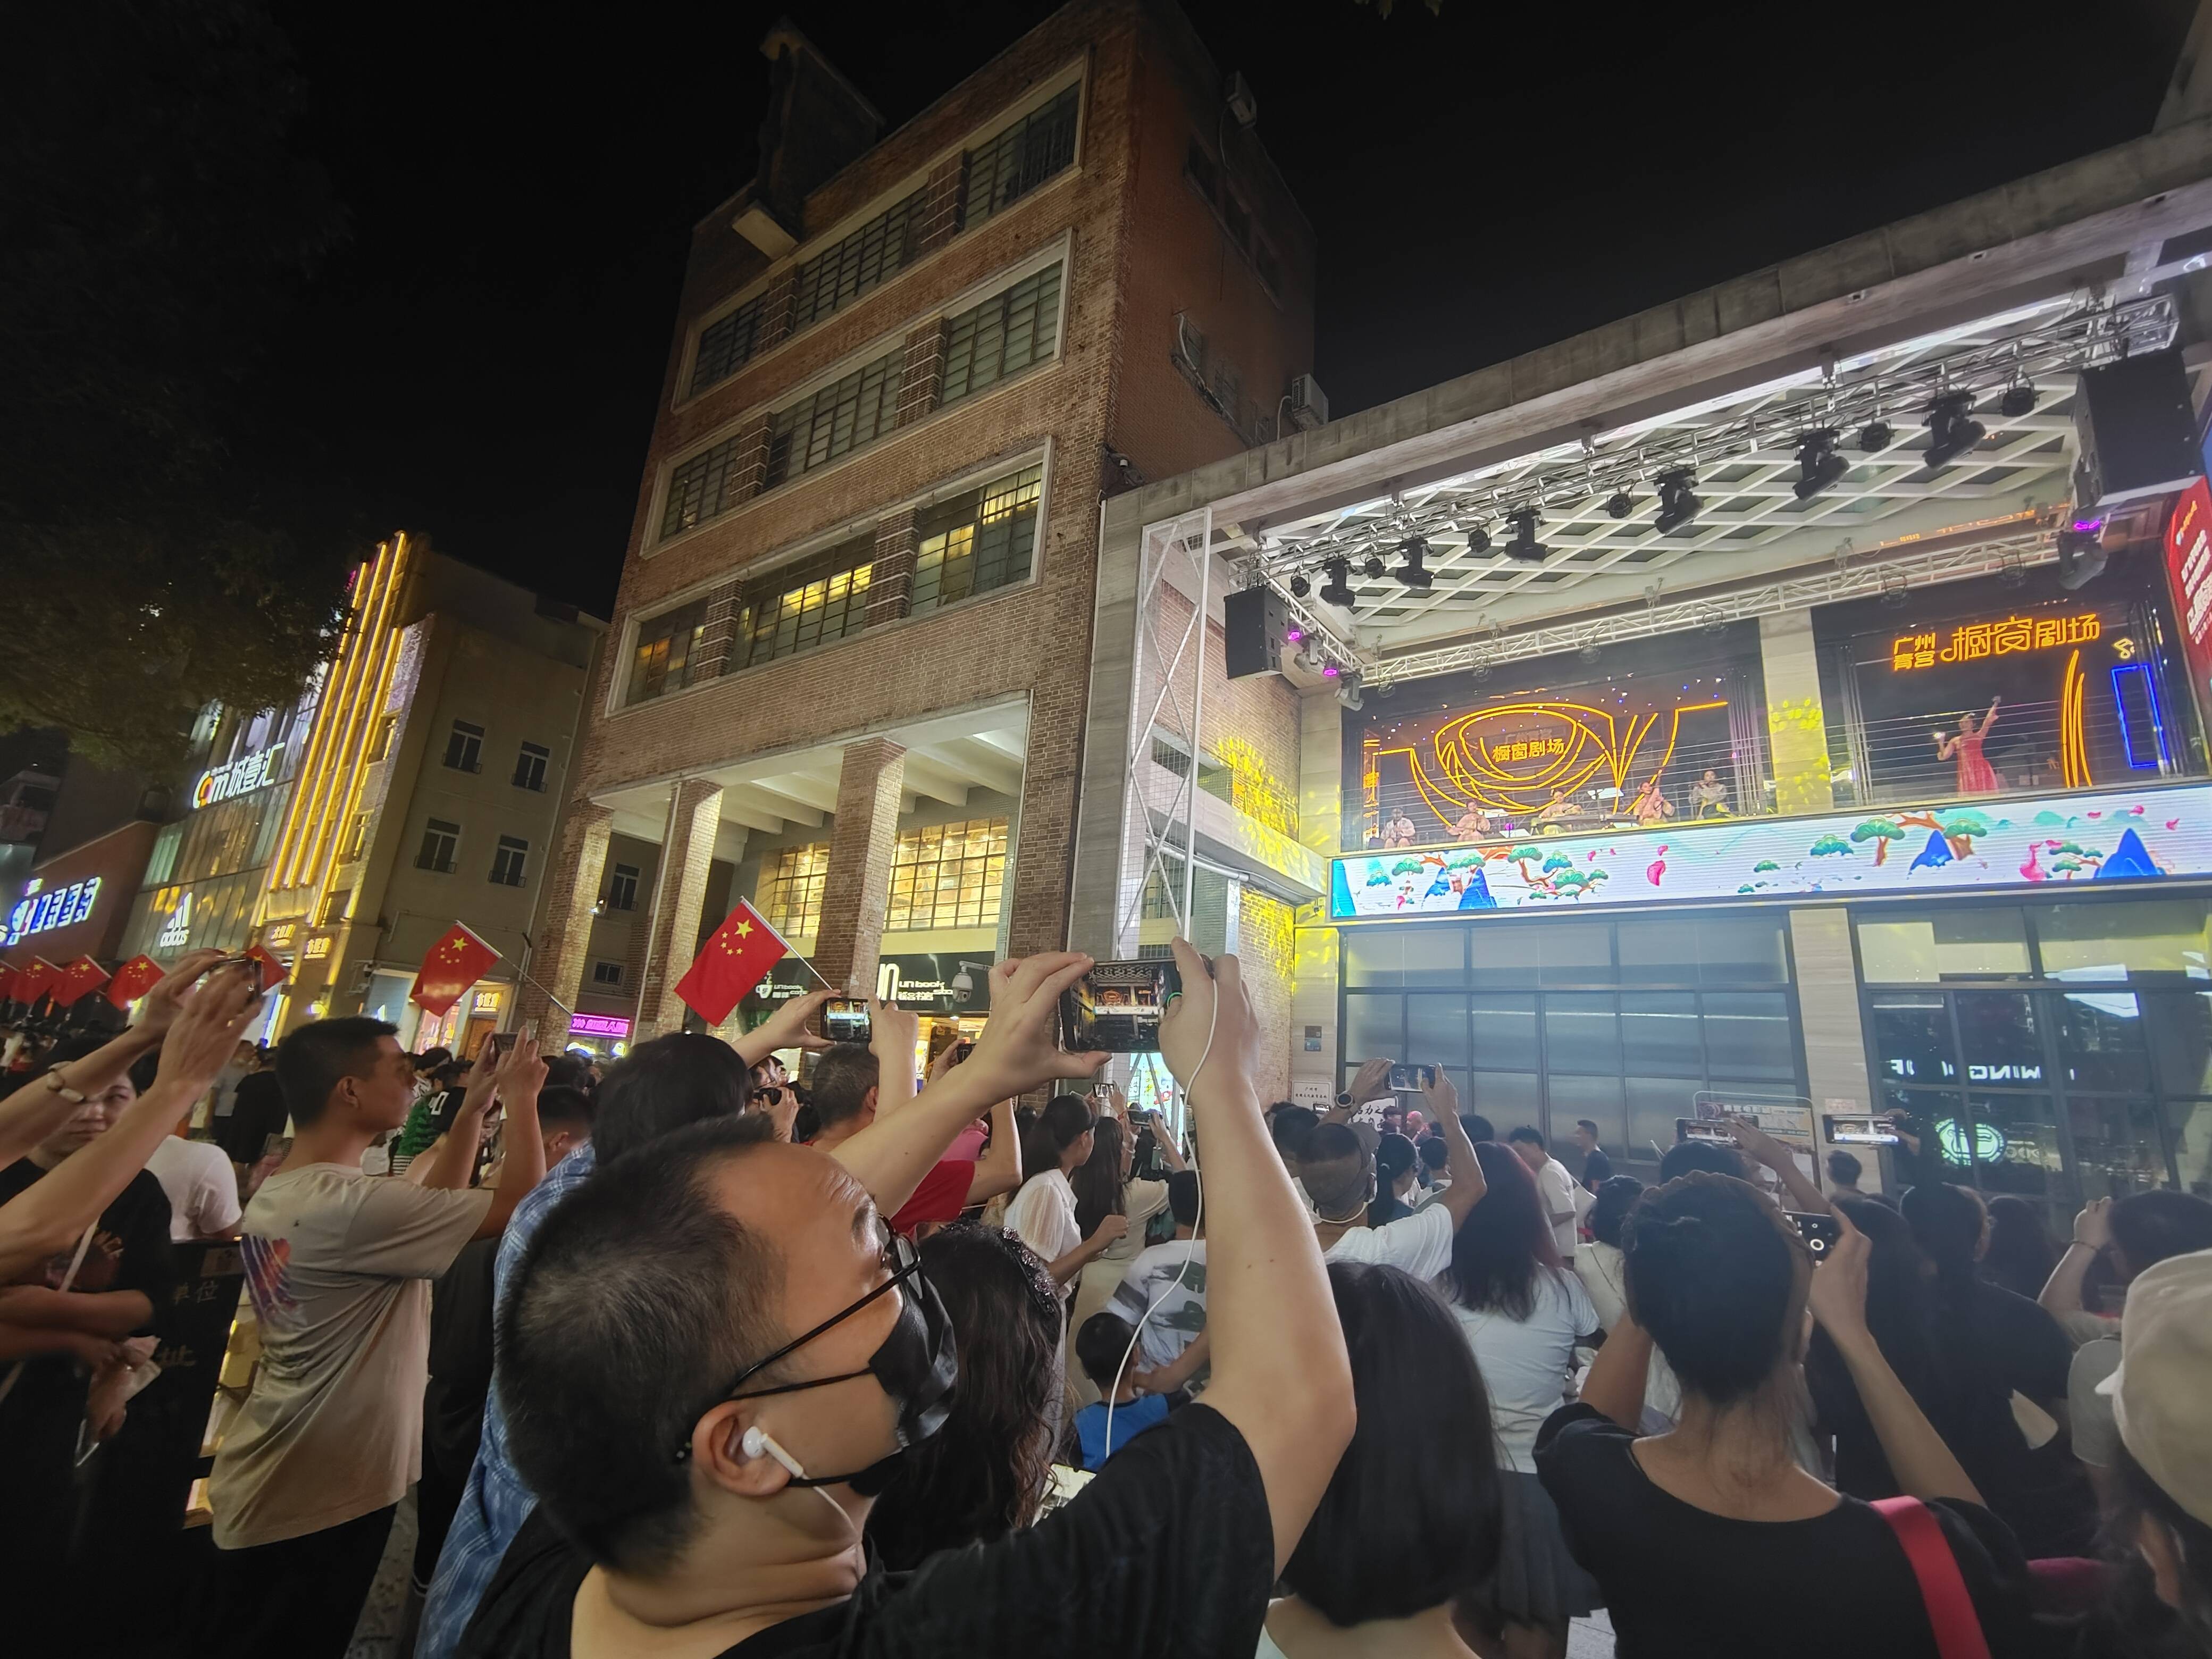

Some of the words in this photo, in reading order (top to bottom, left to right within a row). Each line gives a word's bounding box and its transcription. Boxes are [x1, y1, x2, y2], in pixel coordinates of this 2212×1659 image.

[1893, 632, 1936, 654] 广州
[1893, 650, 1936, 671] 青宫
[1493, 738, 1565, 763] 橱窗剧场
[225, 742, 286, 798] 城壹汇
